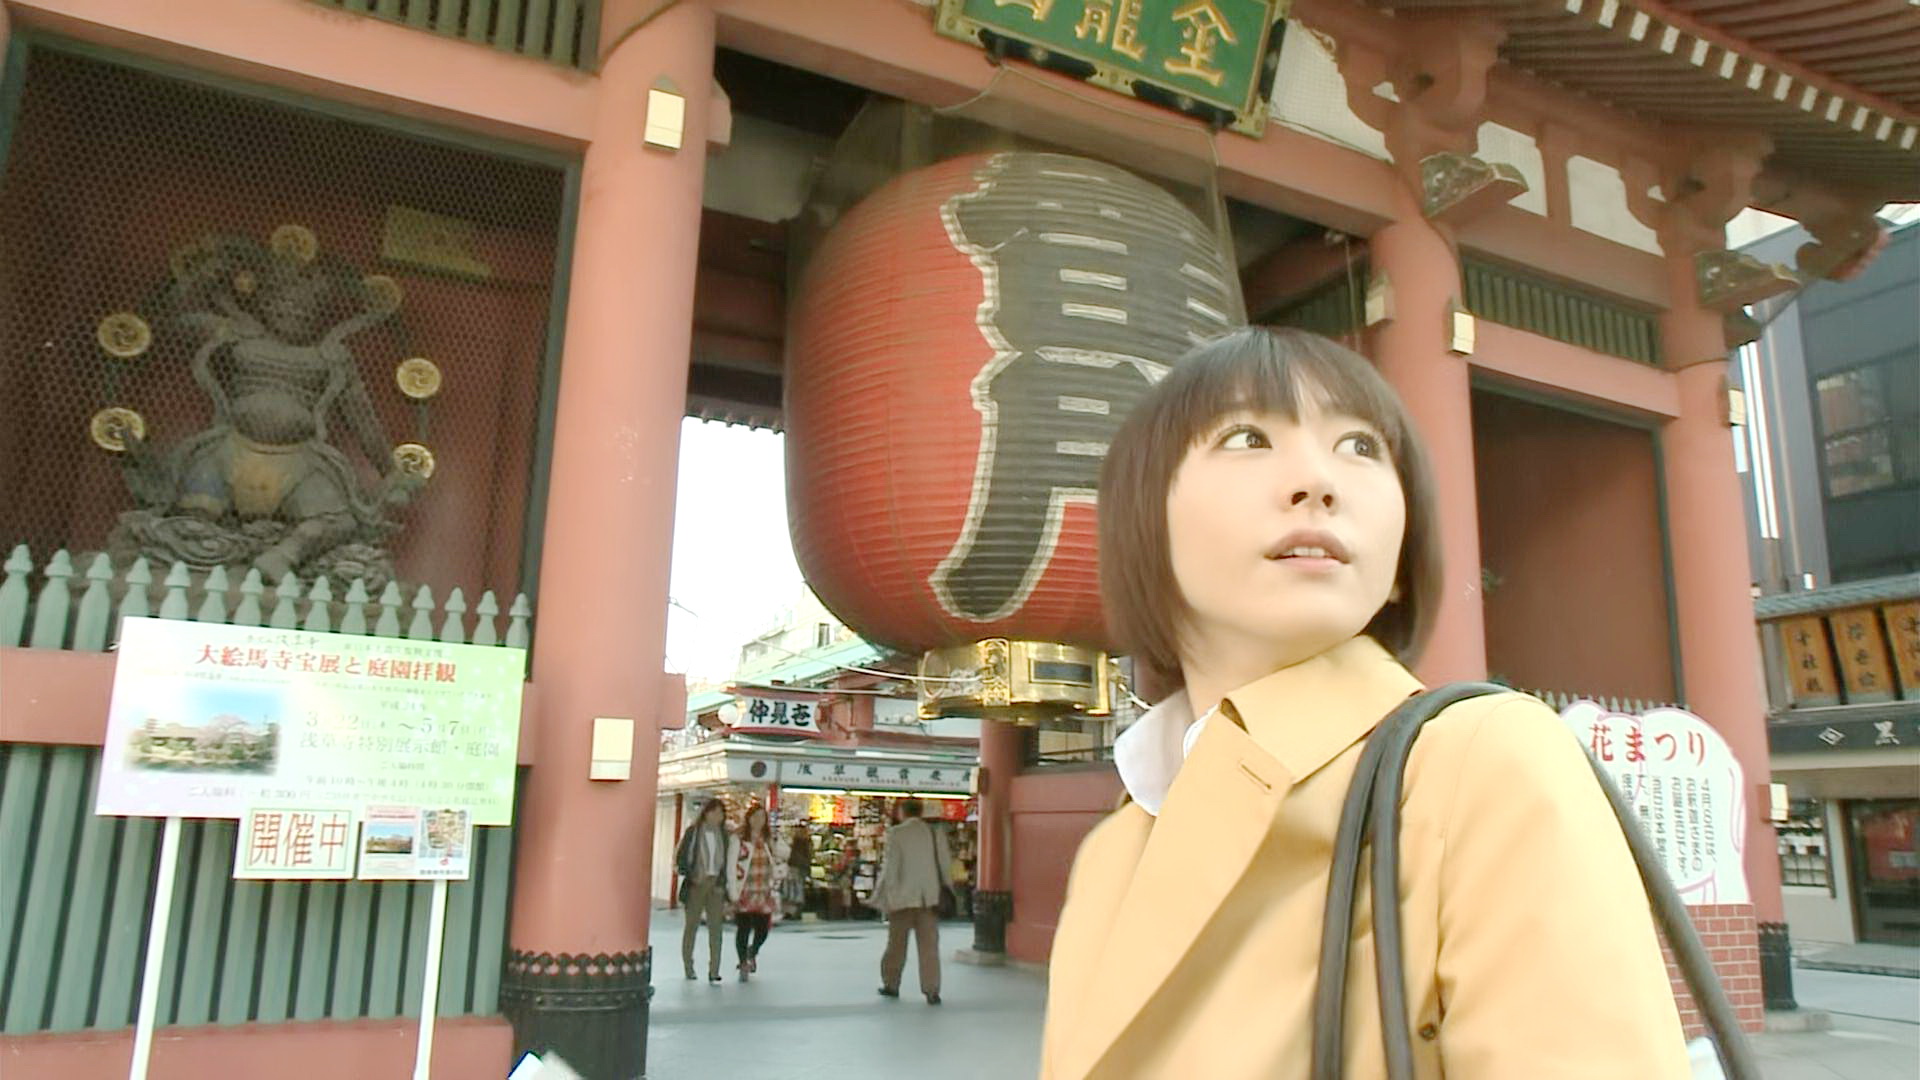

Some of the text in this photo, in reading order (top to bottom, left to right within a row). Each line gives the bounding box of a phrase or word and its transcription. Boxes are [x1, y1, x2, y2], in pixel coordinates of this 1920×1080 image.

[995, 0, 1239, 87] 金龍
[197, 644, 457, 684] 大絵馬寺宝展と庭園拝観
[1589, 723, 1706, 766] 花まつり
[250, 812, 347, 867] 開催中
